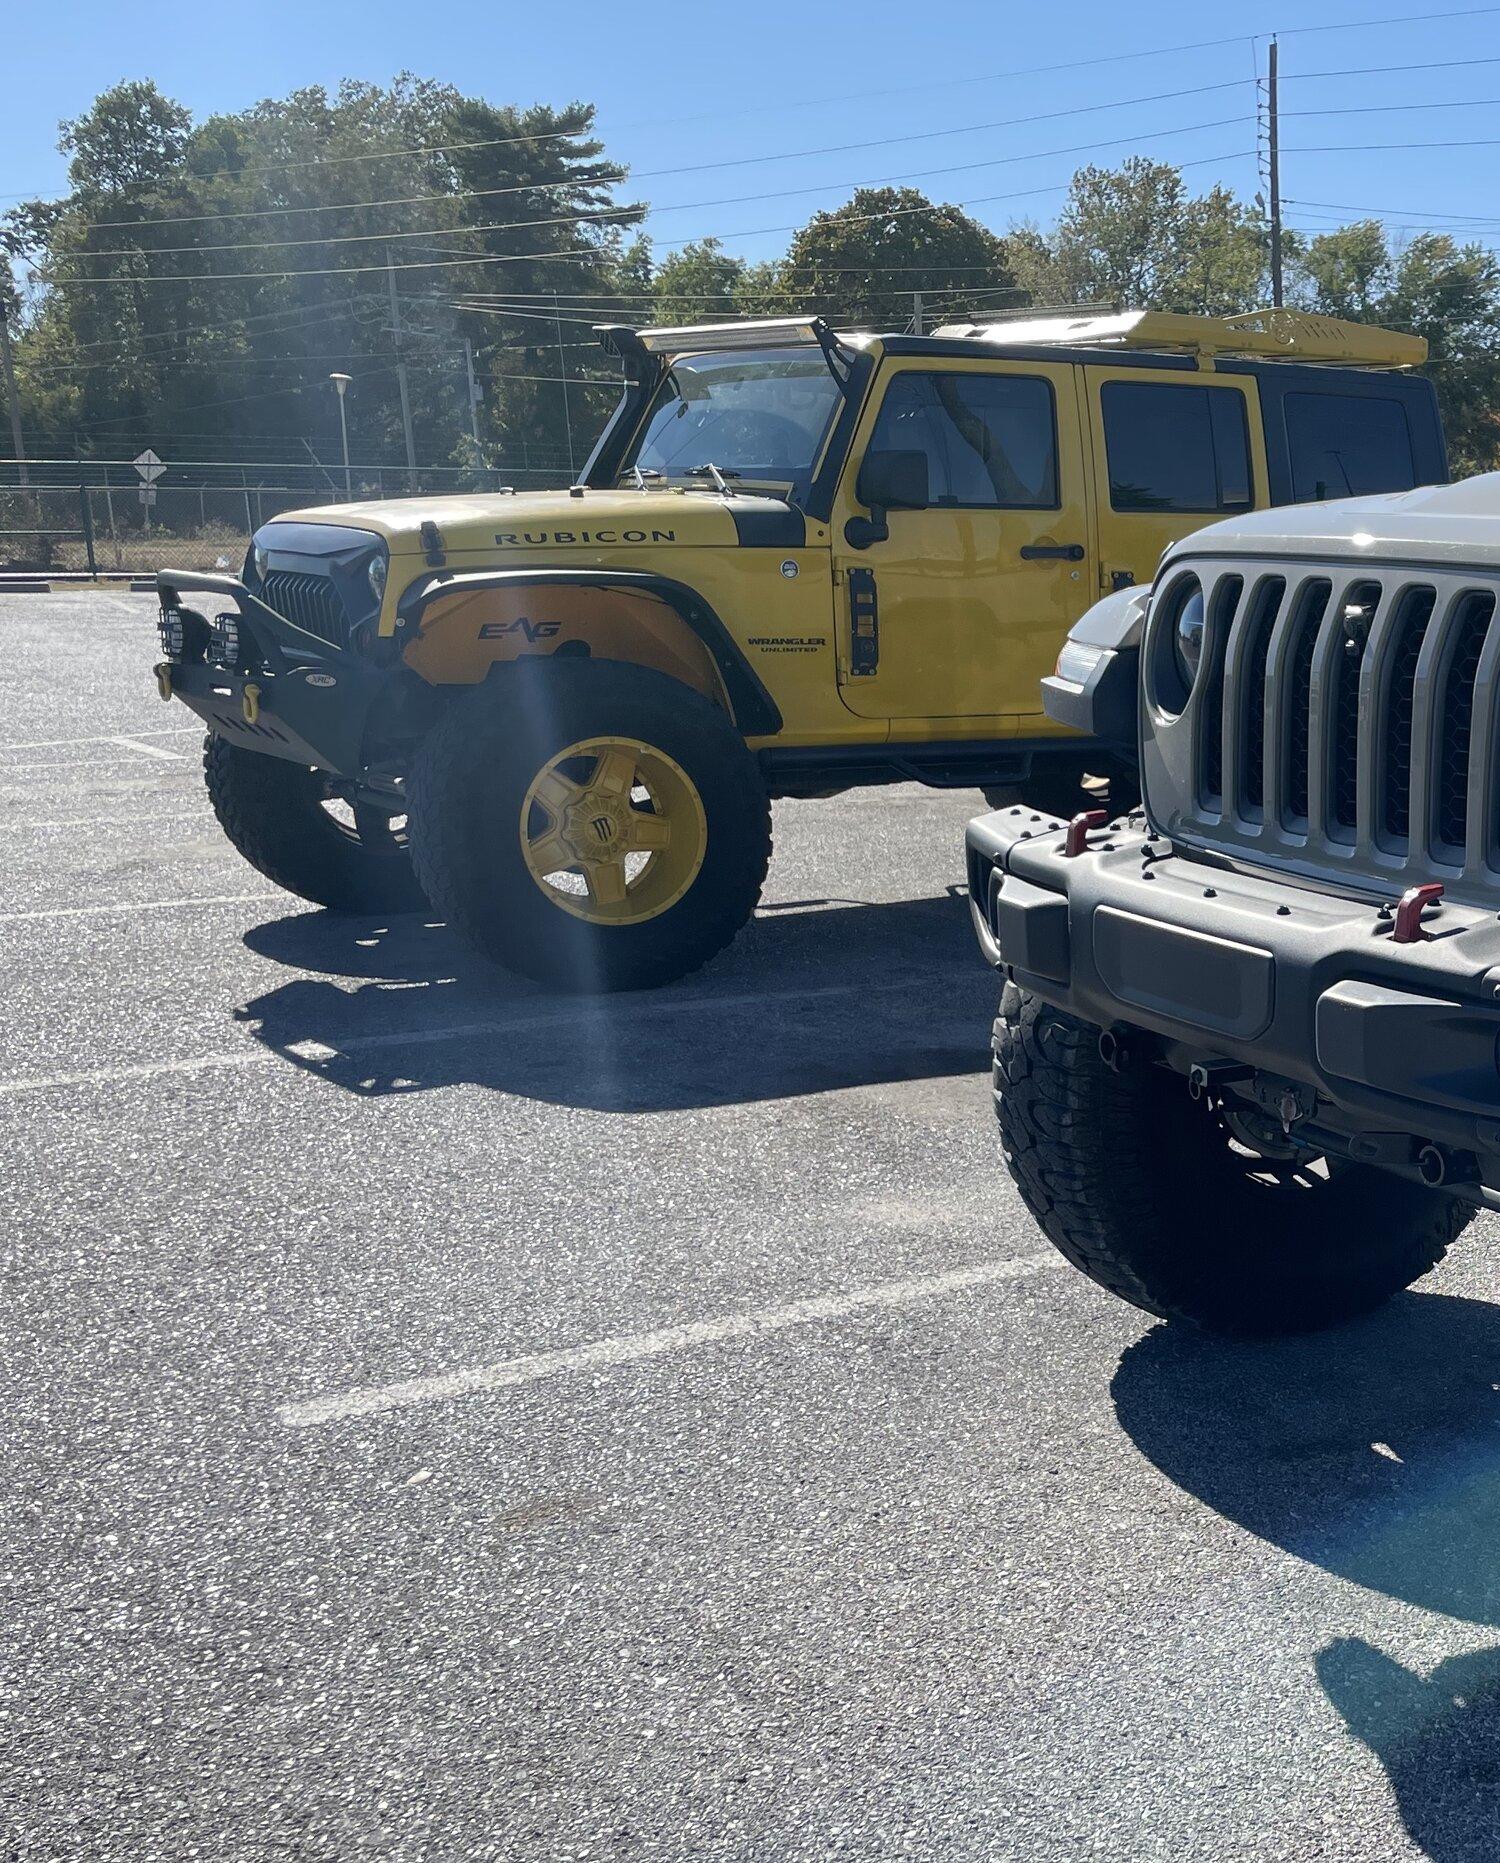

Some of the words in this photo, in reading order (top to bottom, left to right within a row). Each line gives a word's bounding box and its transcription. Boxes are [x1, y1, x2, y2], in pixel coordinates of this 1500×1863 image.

[494, 530, 676, 545] RUBICON
[477, 616, 562, 643] EAG
[747, 638, 826, 646] WRANGLER
